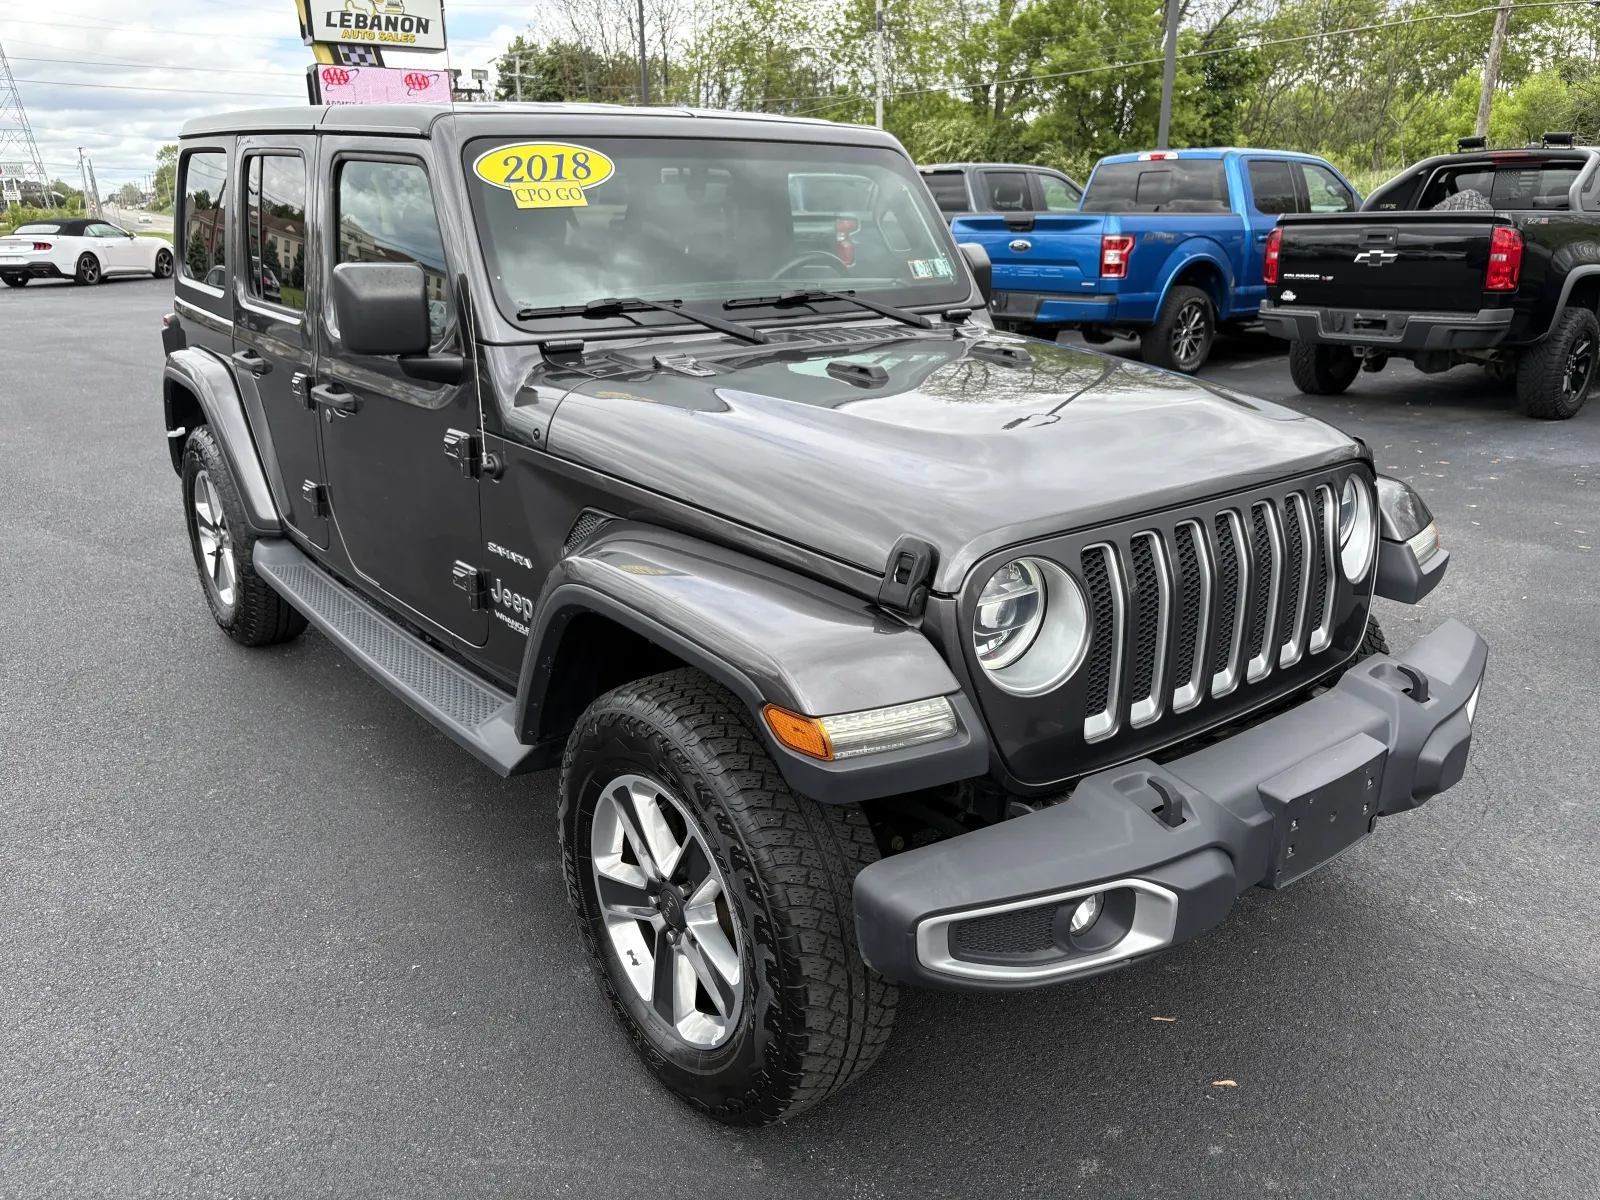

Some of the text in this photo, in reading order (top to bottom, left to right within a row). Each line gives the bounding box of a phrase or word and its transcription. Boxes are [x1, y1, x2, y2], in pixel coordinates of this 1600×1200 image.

[325, 11, 430, 35] LEBANON
[341, 29, 416, 43] AUTO SALES
[323, 69, 349, 85] AAA
[405, 73, 430, 90] AAA
[503, 152, 592, 183] 2018
[515, 187, 582, 202] CPO GO
[487, 541, 533, 569] SAHARA
[490, 578, 533, 622] Jeep
[494, 609, 530, 633] WRANGLE
